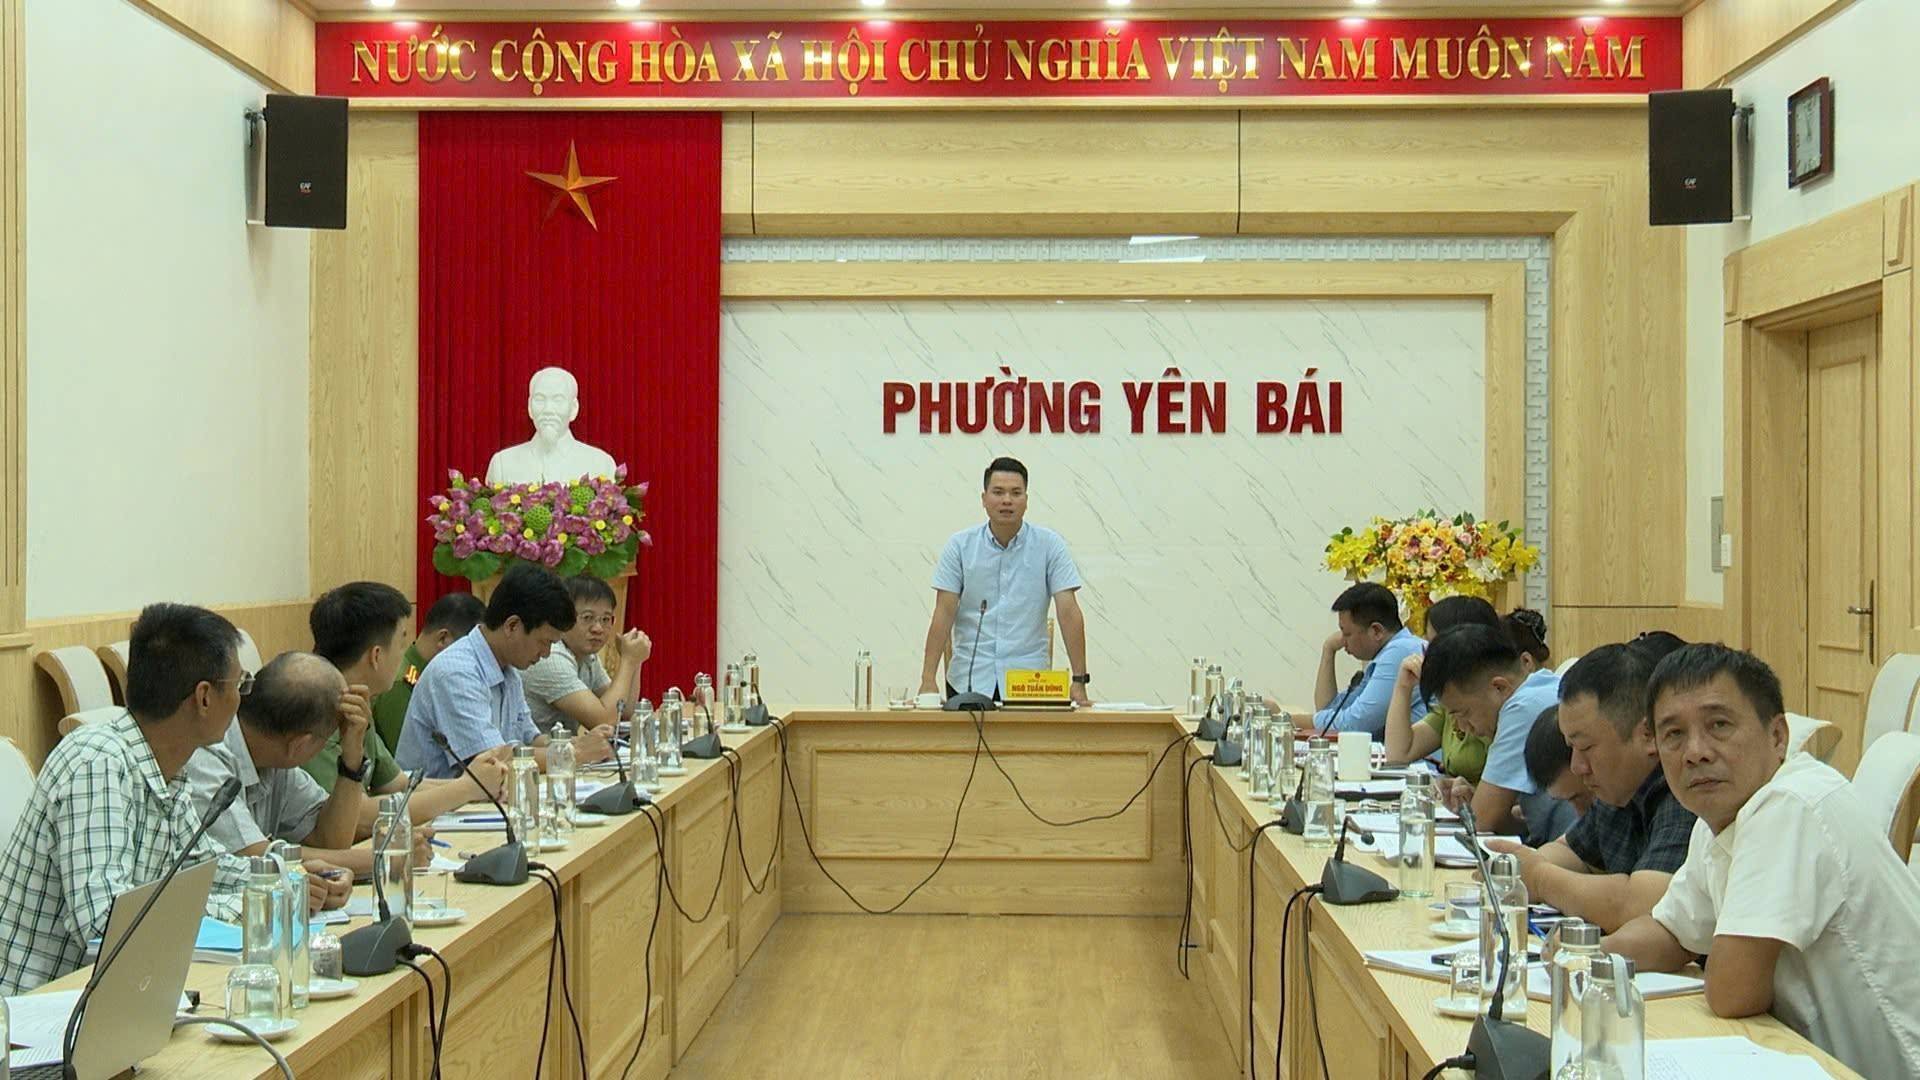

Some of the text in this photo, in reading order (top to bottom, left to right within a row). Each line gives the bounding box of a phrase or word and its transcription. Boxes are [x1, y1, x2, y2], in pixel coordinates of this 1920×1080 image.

[351, 25, 1645, 95] NƯỚC CỘNG HÒA XÃ HỘI CHỦ NGHĨA VIỆT NAM MUÔN NĂM
[882, 366, 1342, 434] PHƯỜNG YÊN BÁI
